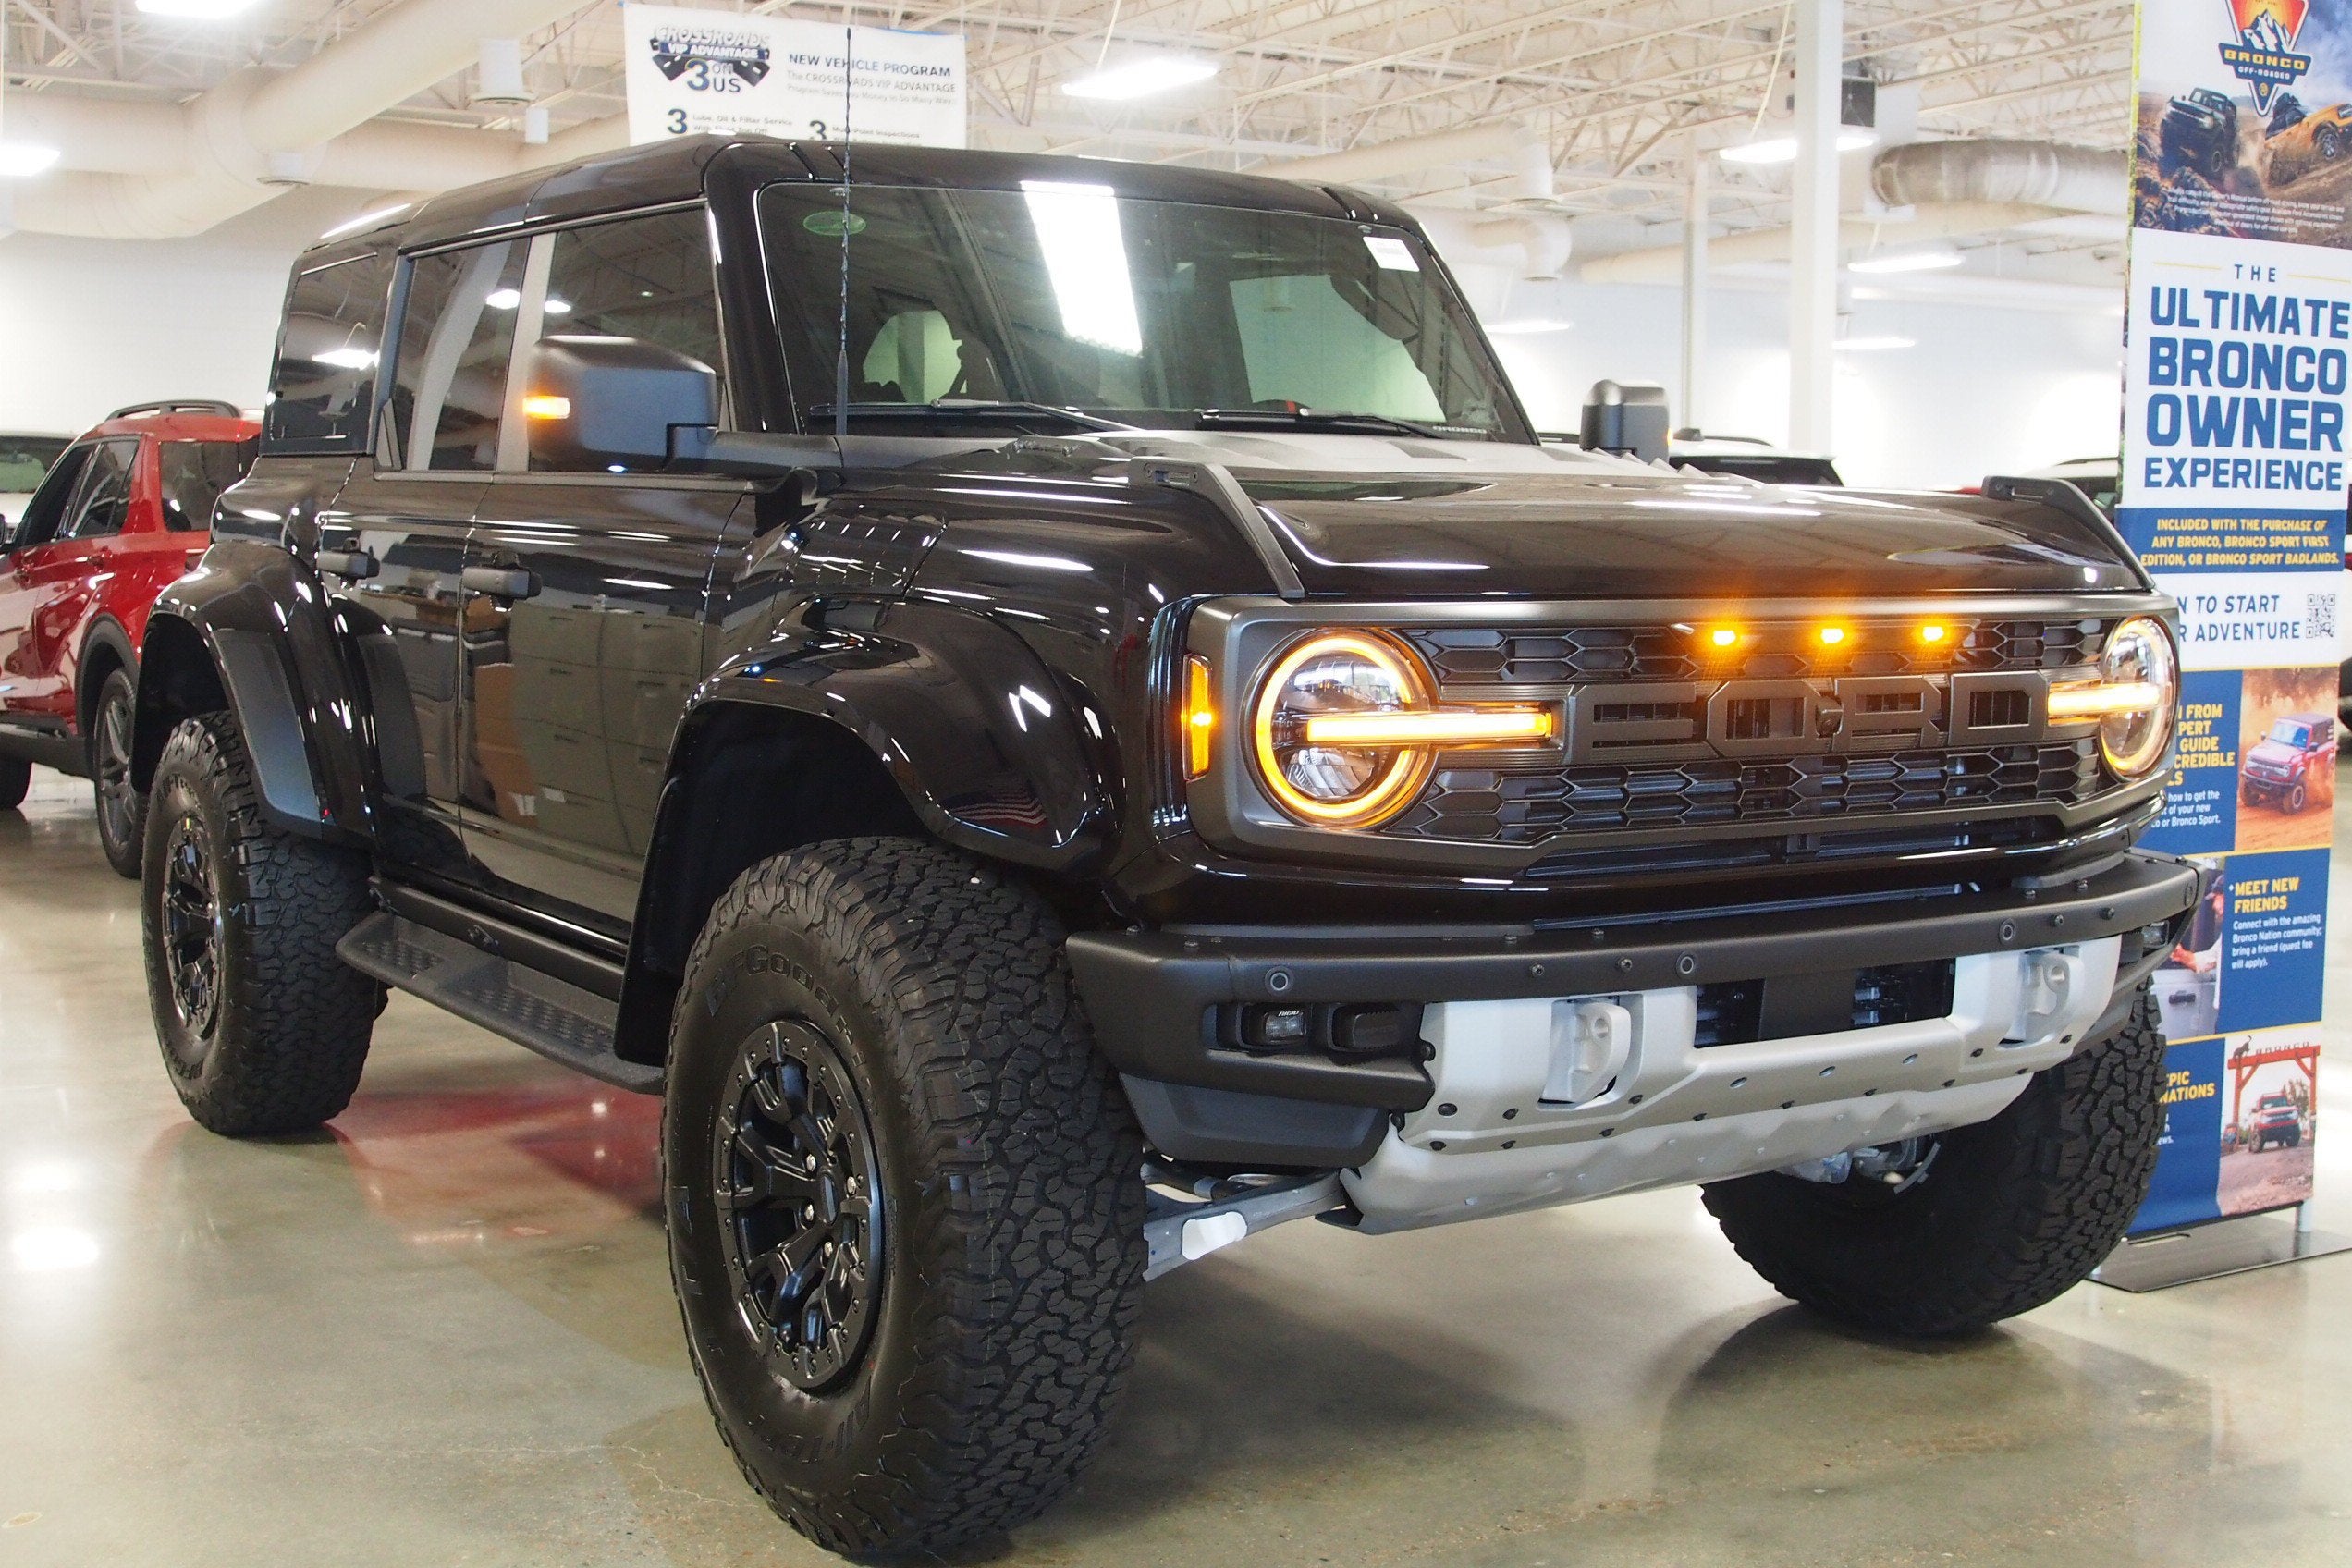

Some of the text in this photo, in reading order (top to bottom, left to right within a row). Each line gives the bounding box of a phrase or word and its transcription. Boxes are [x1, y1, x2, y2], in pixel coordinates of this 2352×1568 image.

[655, 24, 770, 47] CROSSROADS
[668, 43, 759, 59] VIP ADVANTAGE
[2224, 49, 2306, 70] BRONCO
[789, 54, 951, 77] NEW VEHICLE PROGRAM
[2238, 66, 2291, 80] OFF-ROADEO
[685, 58, 734, 92] 3 ON
[713, 78, 741, 93] US
[893, 80, 956, 92] ADVANTAGE
[667, 108, 688, 134] 3
[809, 119, 827, 140] 3
[2234, 263, 2277, 283] THE
[2150, 286, 2350, 339] ULTIMATE
[2148, 337, 2347, 395] BRONCO
[2146, 393, 2343, 452] OWNER
[2144, 457, 2343, 492] EXPERIENCE
[2157, 519, 2328, 532] INCLUDED WITH THE PURCHASE OF
[2151, 535, 2329, 549] ANY BRONCO, BRONCO SPORT FIRST
[2140, 552, 2340, 567] EDITION, OR BRONCO SPORT BADLANDS.
[2196, 595, 2217, 614] TO
[2224, 595, 2280, 614] START
[2195, 621, 2300, 642] ADVENTURE
[1567, 669, 2047, 764] FORD
[2186, 704, 2223, 719] FROM
[2178, 720, 2212, 737] PERT
[2179, 736, 2219, 753] GUIDE
[2174, 751, 2236, 769] CREDIBLE
[2168, 790, 2221, 802] how to get the
[2168, 803, 2176, 815] of
[2177, 804, 2195, 815] your
[2196, 803, 2211, 813] new
[2162, 818, 2170, 827] or
[2171, 815, 2198, 827] Bronco
[2235, 876, 2300, 896] MEET NEW
[2234, 895, 2288, 914] FRIENDS
[2233, 913, 2321, 931] Connect with the amazing
[2232, 933, 2258, 944] Bronco
[2259, 930, 2282, 941] Nation
[2231, 939, 2313, 957] bring a friend (guest fee
[2231, 958, 2244, 970] will
